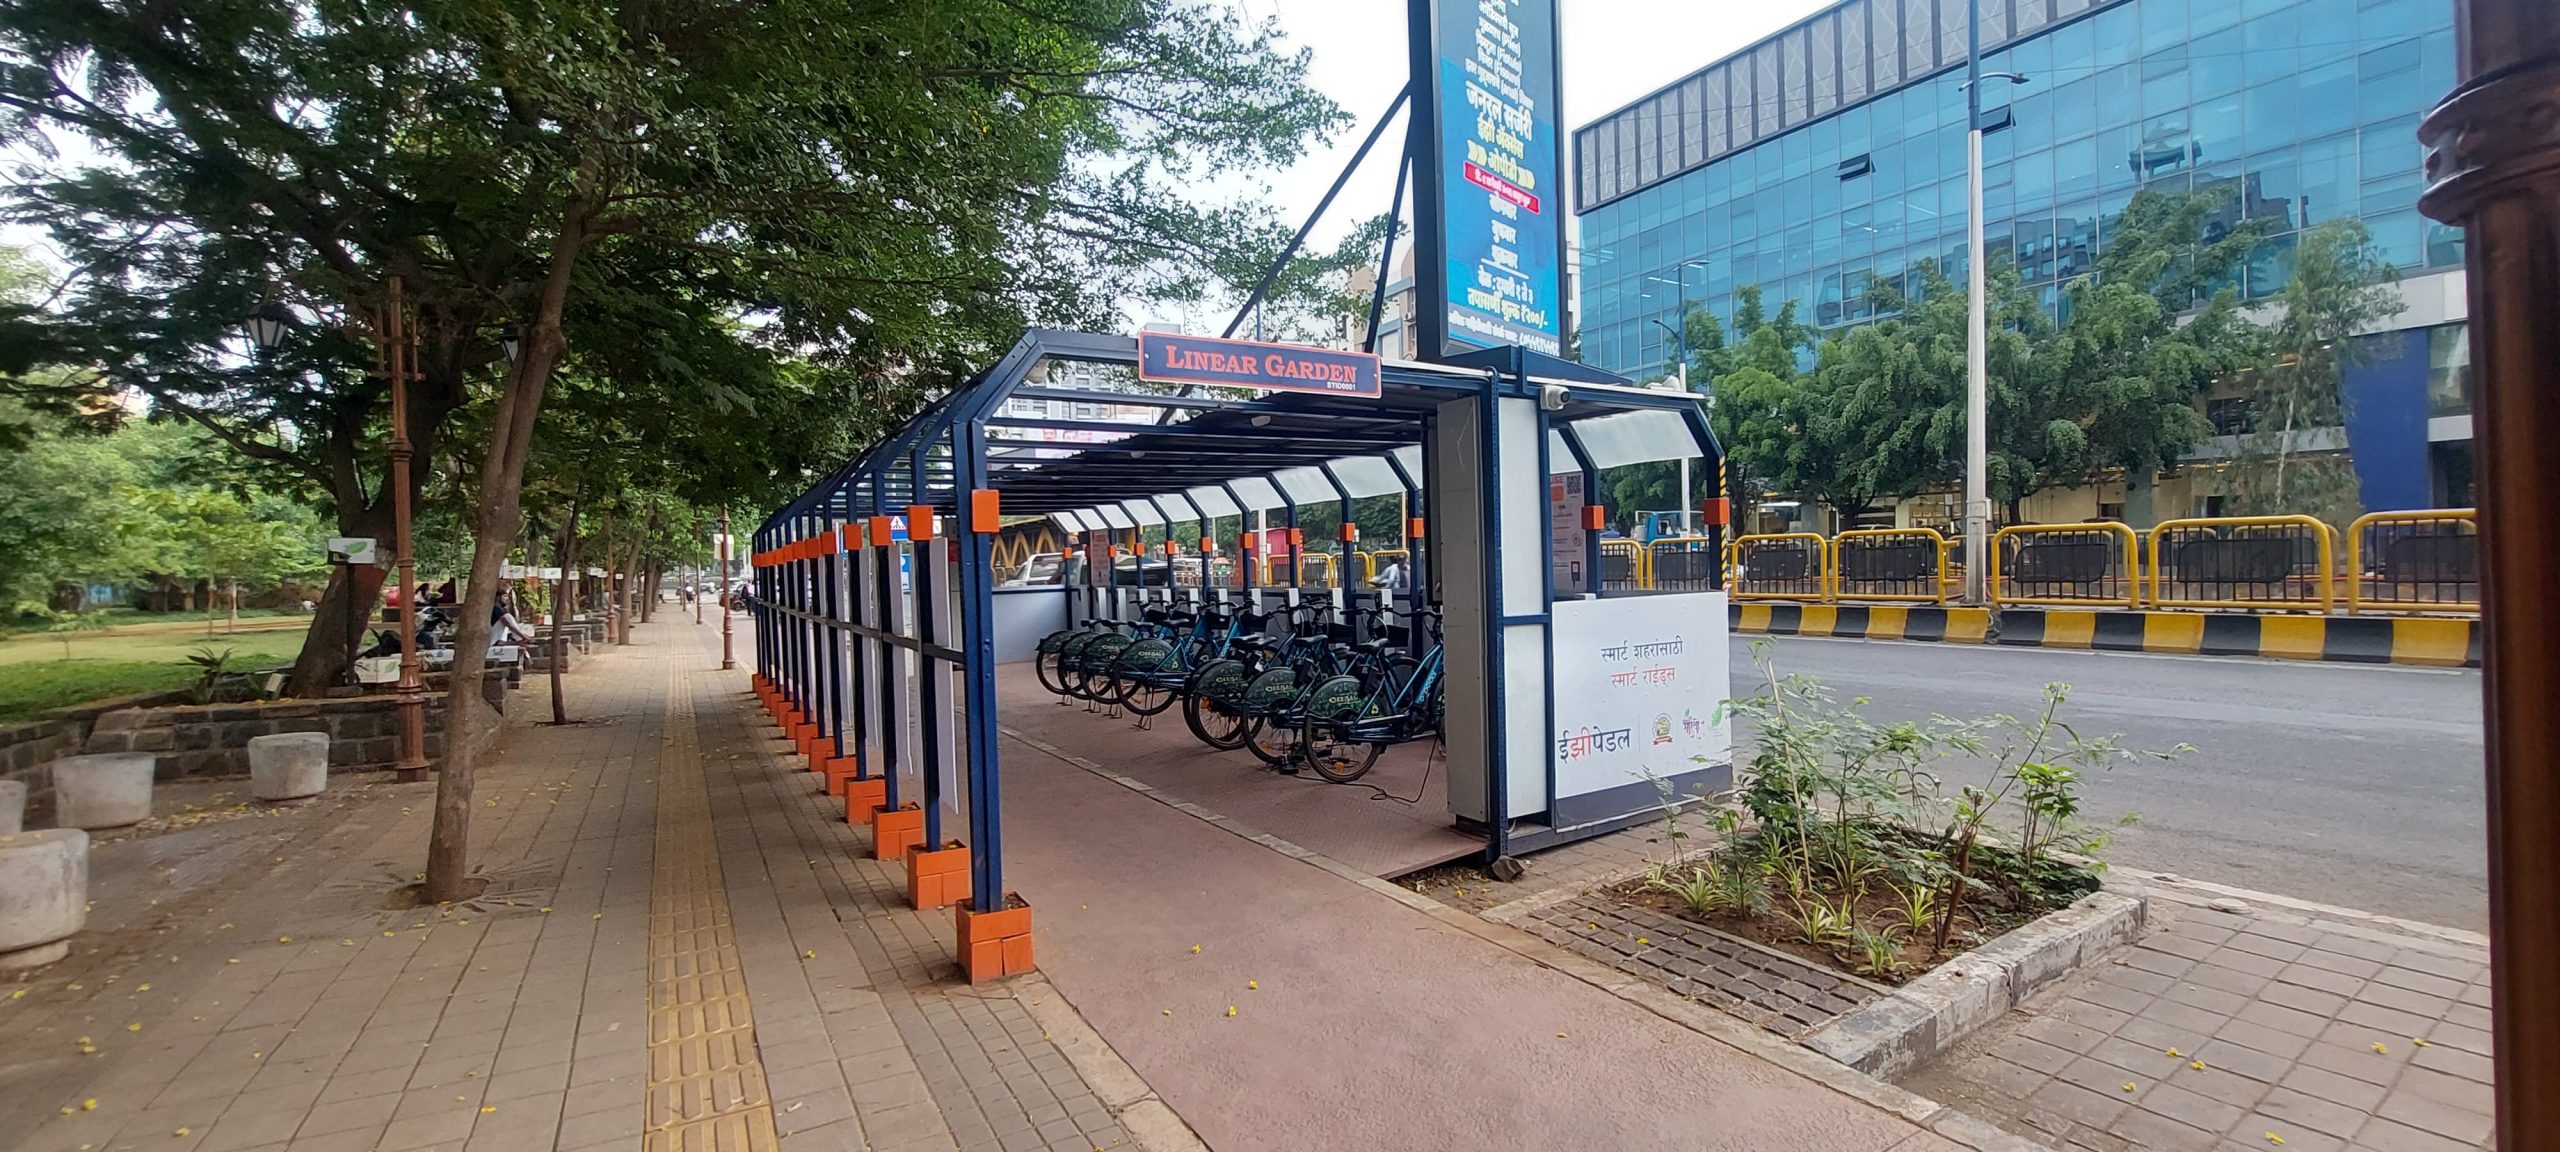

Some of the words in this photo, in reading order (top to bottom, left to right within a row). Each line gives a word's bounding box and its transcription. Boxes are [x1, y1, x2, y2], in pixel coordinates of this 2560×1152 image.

[1465, 80, 1503, 123] जनरल
[1503, 103, 1533, 141] सर्जरी
[1488, 148, 1517, 180] ओपीडी
[1326, 381, 1356, 391] STID0001
[1601, 640, 1628, 663] स्मार्ट
[1633, 635, 1684, 660] शहरांसाठी
[1611, 666, 1638, 688] स्मार्ट
[1557, 725, 1632, 765] ईझीपेडल
